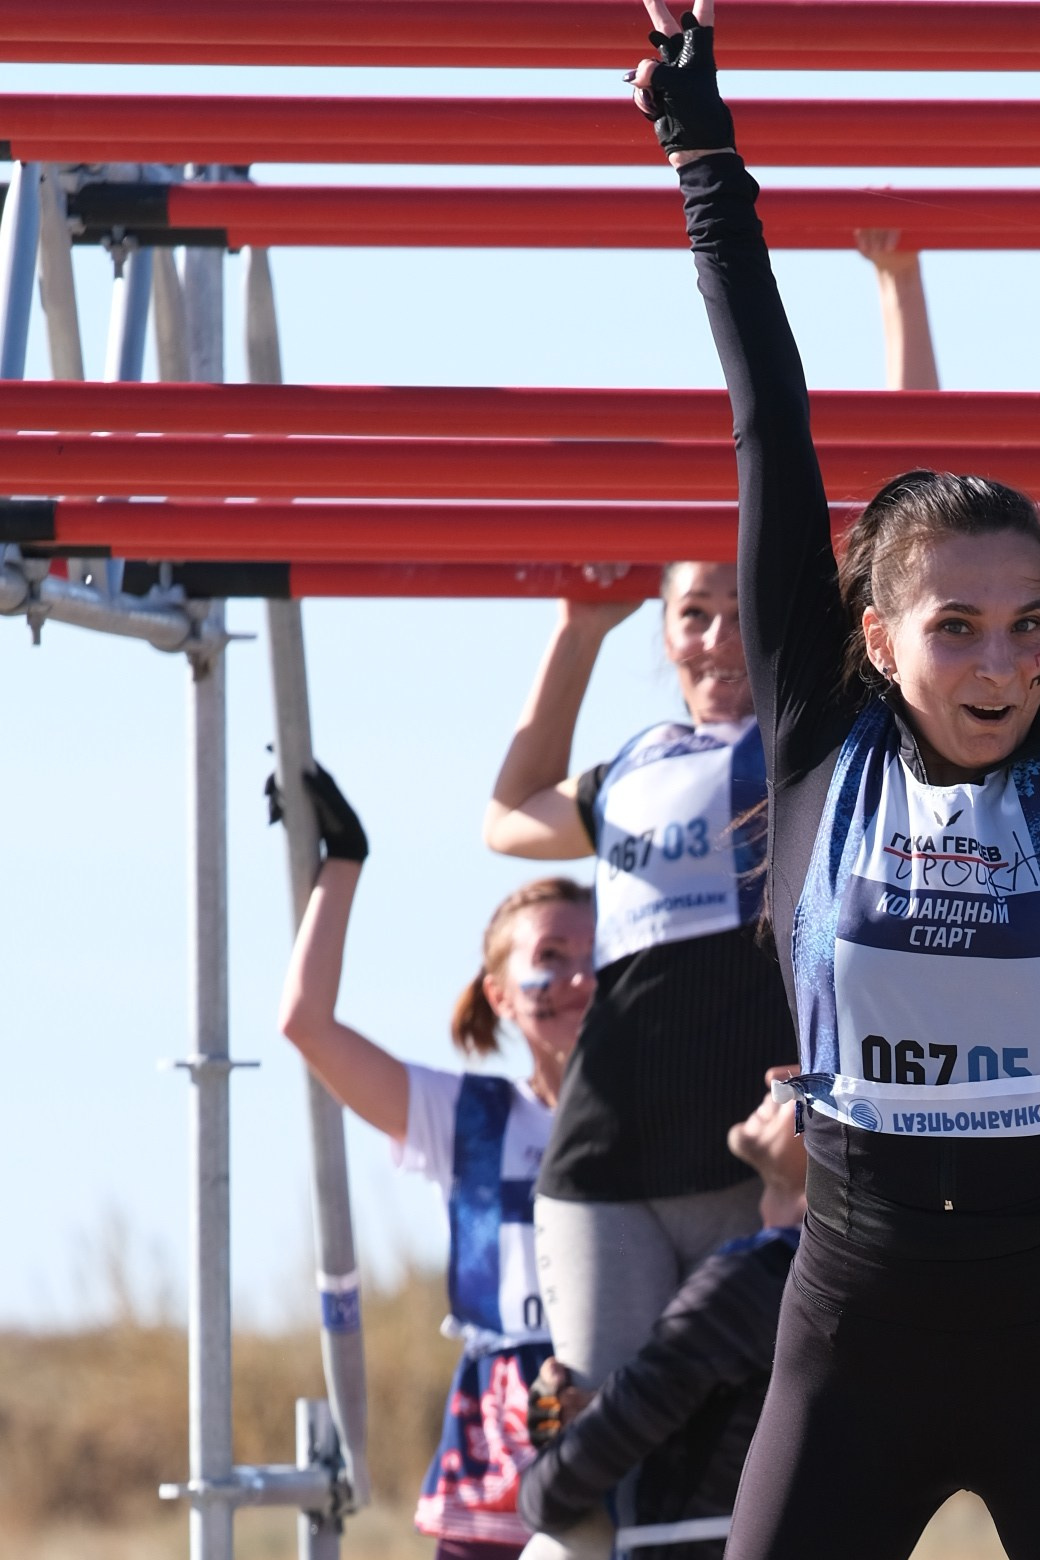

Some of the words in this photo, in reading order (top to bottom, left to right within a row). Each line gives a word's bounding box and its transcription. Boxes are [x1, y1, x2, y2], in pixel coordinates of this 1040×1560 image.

[663, 816, 709, 860] 03
[876, 891, 1010, 924] КОМАНДНЫЙ
[909, 925, 977, 949] СТАРТ
